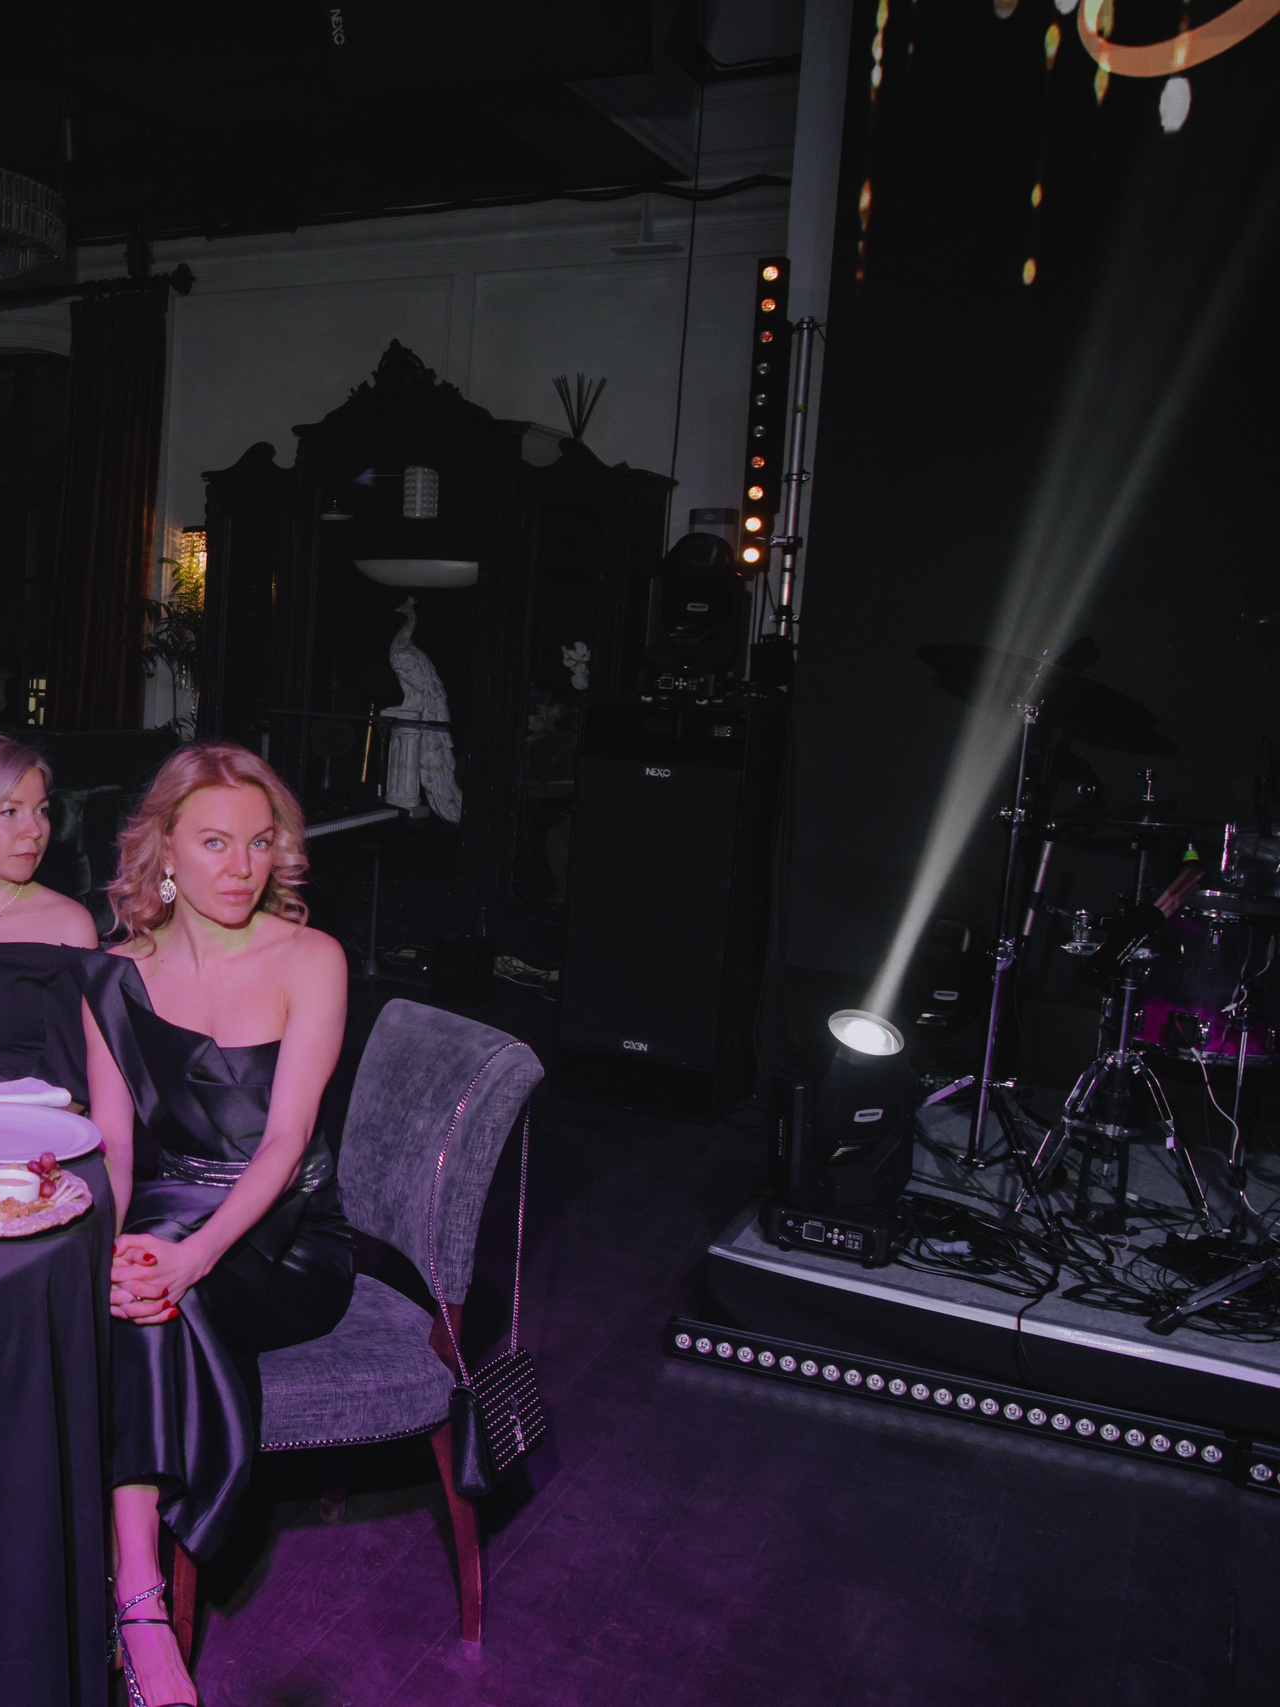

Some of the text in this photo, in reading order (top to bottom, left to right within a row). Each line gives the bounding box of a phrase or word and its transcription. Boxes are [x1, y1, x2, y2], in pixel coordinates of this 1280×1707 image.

[330, 9, 345, 45] NEXO
[645, 767, 671, 778] NEXO
[623, 1040, 648, 1051] NEXO
